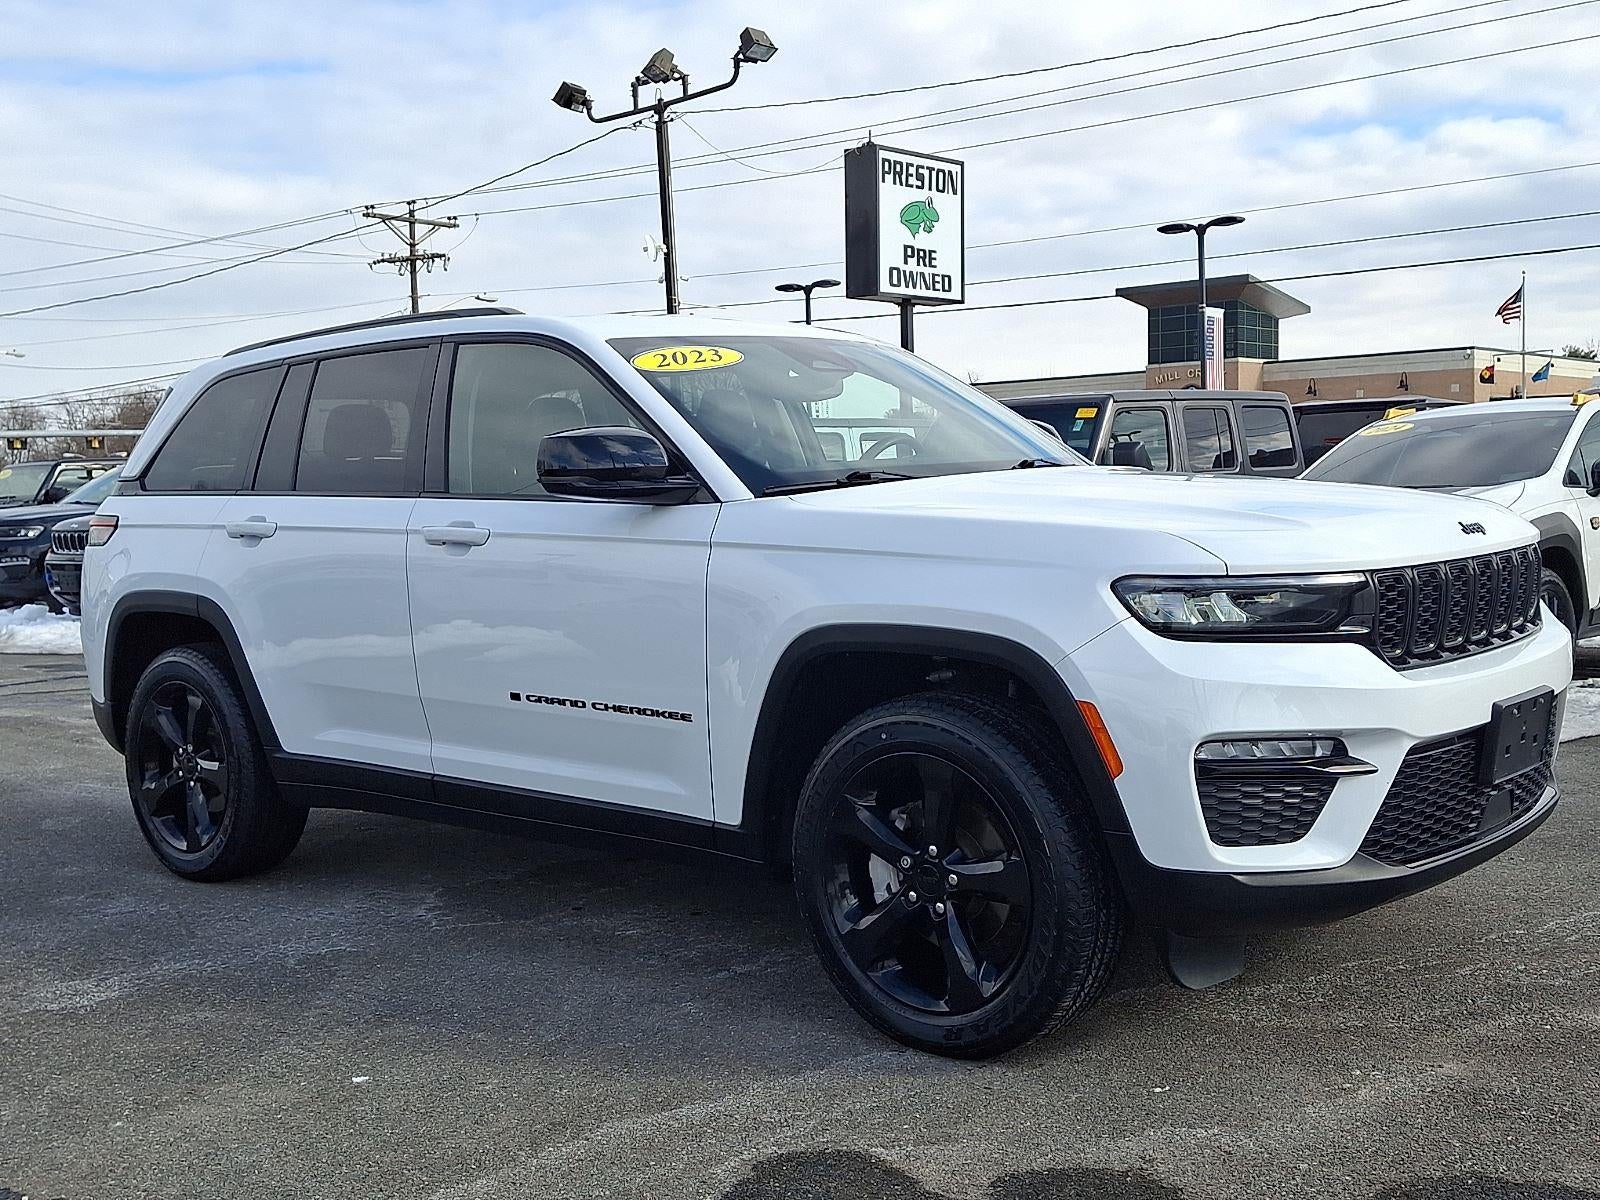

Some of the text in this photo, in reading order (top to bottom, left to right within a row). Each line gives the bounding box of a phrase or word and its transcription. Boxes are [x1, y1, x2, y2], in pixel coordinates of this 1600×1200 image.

[881, 157, 958, 195] PRESTON
[903, 244, 937, 268] PRE
[888, 266, 952, 293] OWNED
[653, 348, 723, 368] 2023
[1155, 371, 1181, 384] MILL
[525, 694, 693, 722] GRAND CHEROKEE
